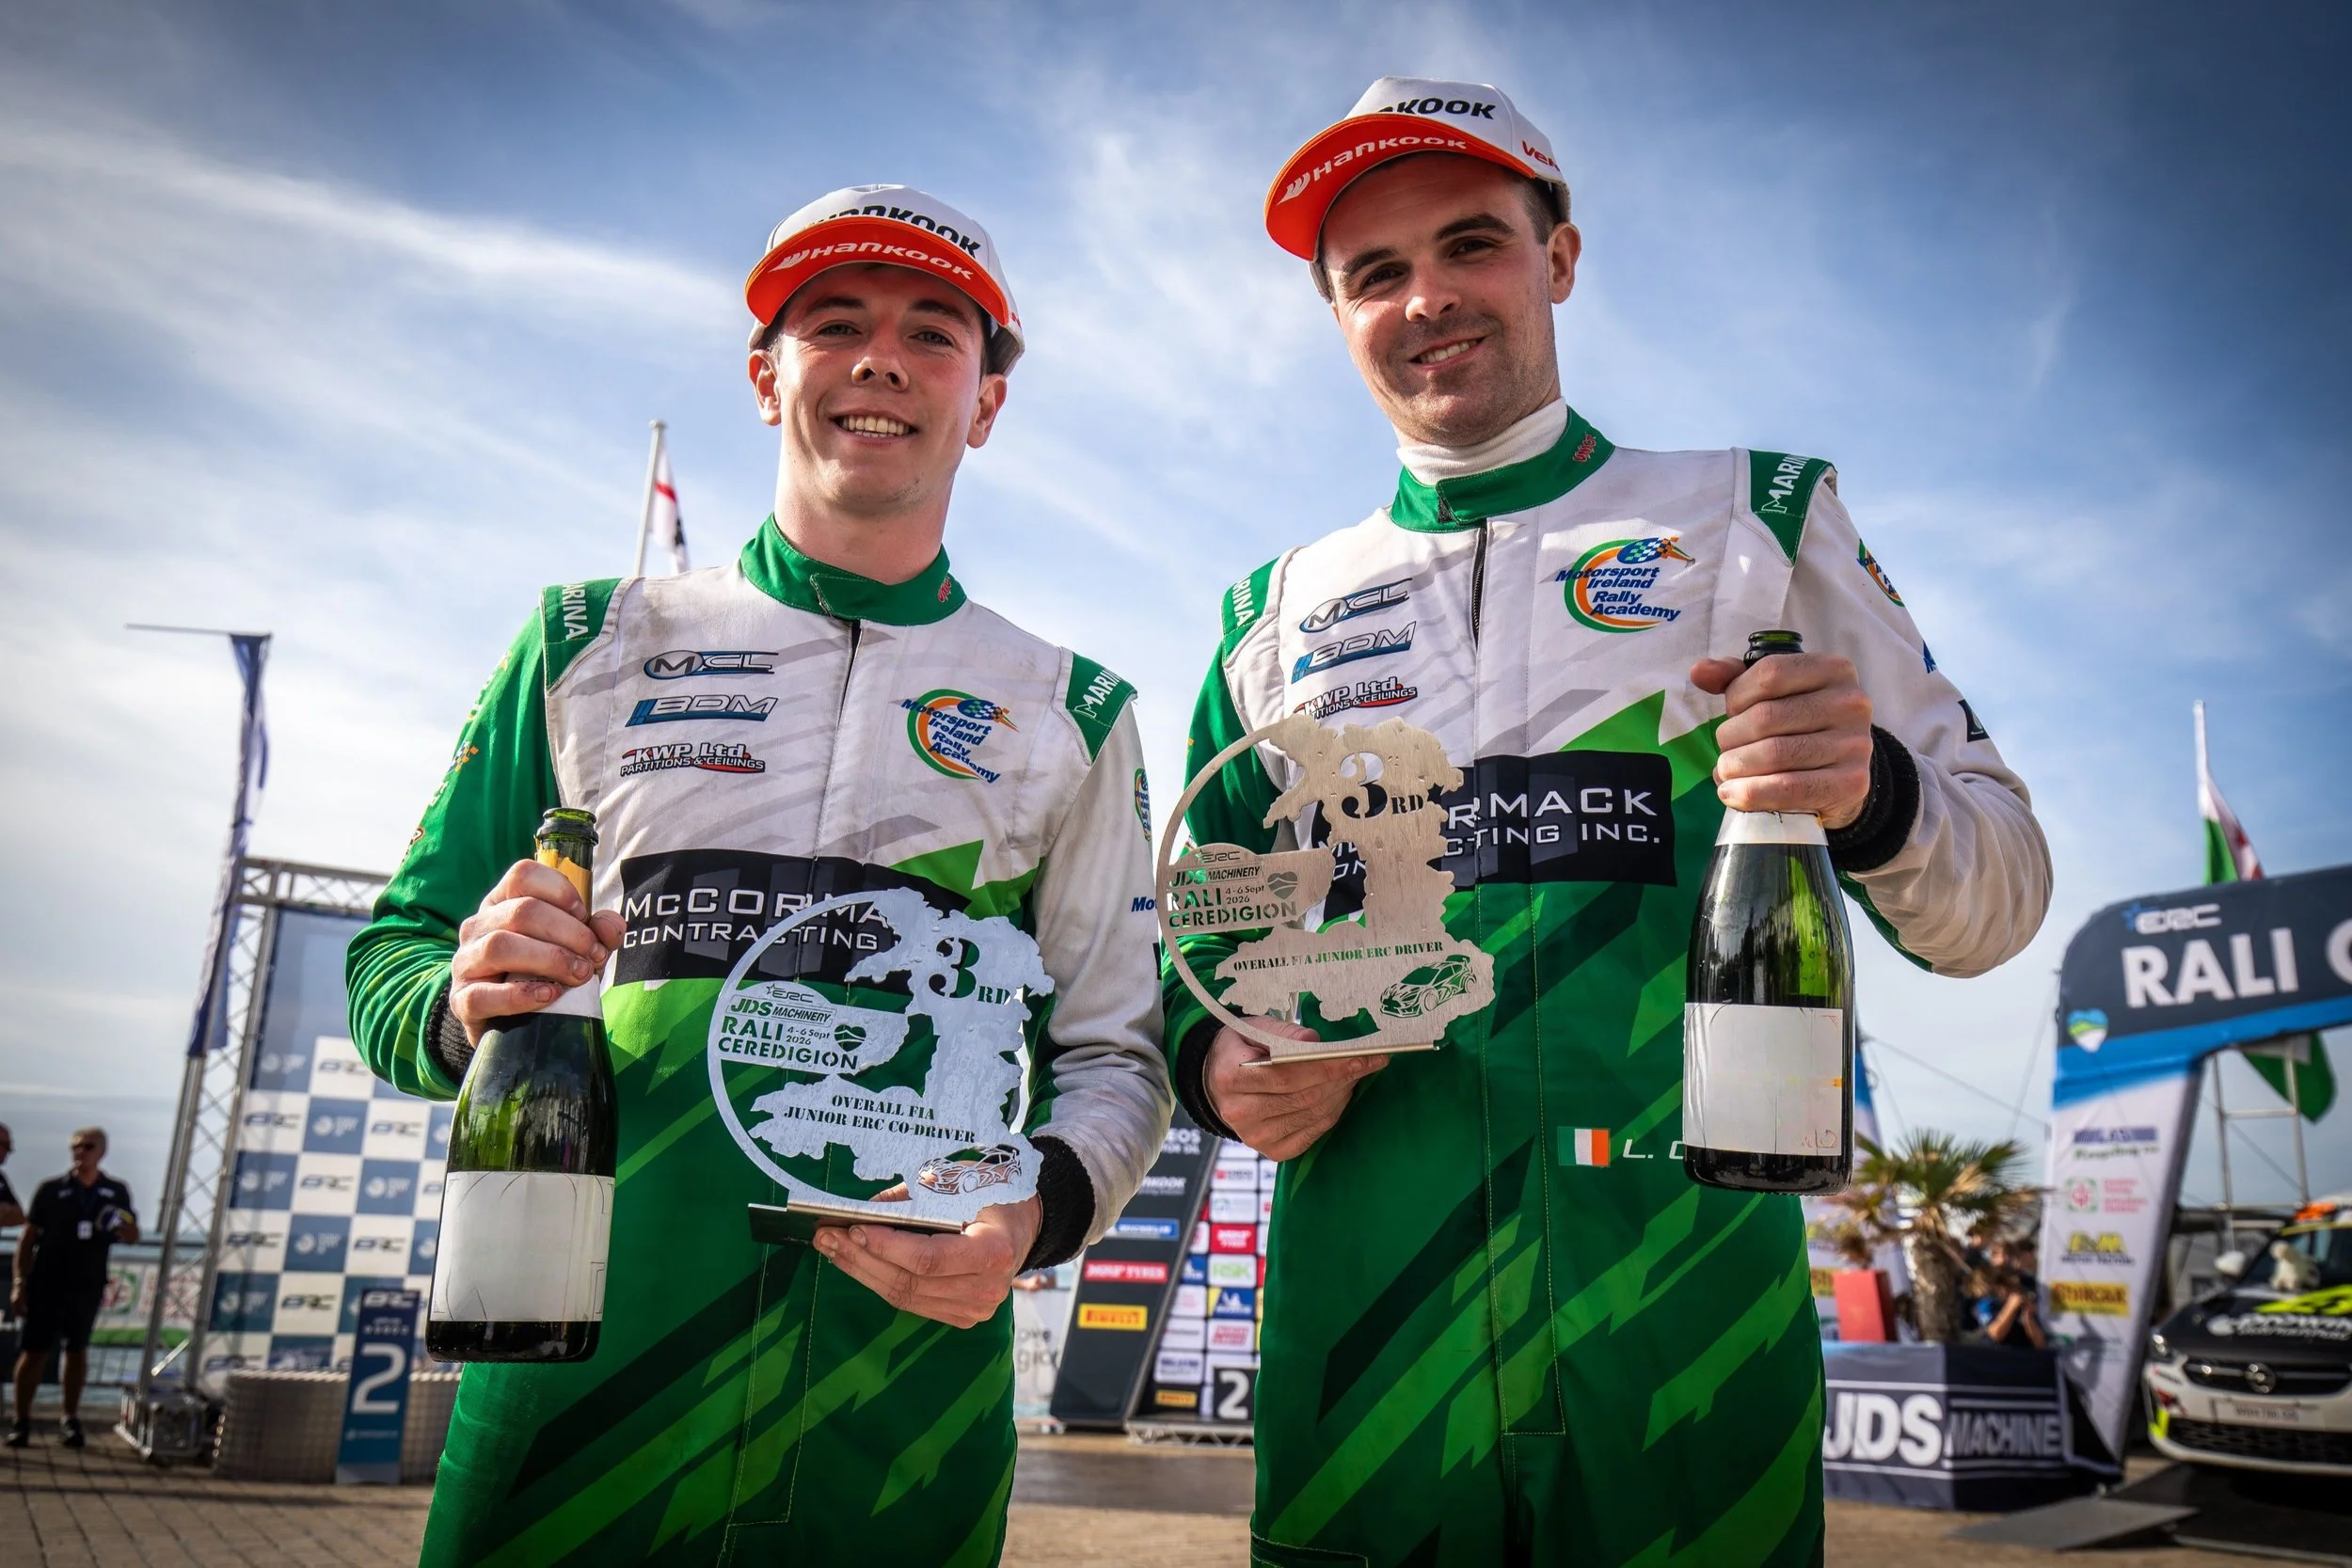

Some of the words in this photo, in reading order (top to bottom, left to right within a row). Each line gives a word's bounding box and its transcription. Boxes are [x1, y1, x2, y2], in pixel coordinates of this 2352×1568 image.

[1760, 456, 1810, 514] MARIN
[1555, 566, 1661, 582] Motorsport
[1586, 577, 1654, 590] Ireland
[1592, 590, 1642, 605] Rally
[1590, 602, 1682, 622] Academy
[1074, 670, 1122, 719] MARIN
[1304, 687, 1349, 715] KWP
[1357, 676, 1403, 696] Ltd.
[1352, 696, 1362, 706] &
[1363, 687, 1418, 704] CEILINGS
[900, 698, 993, 735] Motorsport
[928, 717, 986, 746] Ireland
[931, 731, 972, 757] Rally
[620, 755, 691, 776] PARTITIONS
[692, 755, 706, 767] &
[706, 757, 765, 772] CEILINGS
[634, 743, 692, 763] KWP
[699, 742, 752, 760] Ltd.
[929, 741, 1002, 784] Academy
[1581, 823, 1661, 844] INC.
[1169, 868, 1207, 887] JDS
[1208, 866, 1260, 881] MACHINERY
[1245, 885, 1264, 895] Sept
[1167, 888, 1222, 911] RALI
[1226, 895, 1250, 904] 2026
[1168, 901, 1297, 929] CEREDIGION
[623, 923, 878, 950] CONTRATING
[1233, 956, 1289, 972] OVERALL
[1292, 952, 1312, 967] FIA
[1315, 948, 1364, 965] JUNIOR
[1366, 945, 1391, 959] ERC
[1394, 941, 1444, 956] DRIVER
[2122, 927, 2299, 1008] RALI
[731, 996, 773, 1017] JDS
[771, 1006, 832, 1024] MACHINERY
[721, 1016, 783, 1041] RALI
[786, 1035, 812, 1046] 2026
[808, 1029, 830, 1040] Sept
[718, 1037, 859, 1070] CEREDIGION
[832, 1094, 905, 1117] OVERALL
[907, 1104, 935, 1121] FIA
[784, 1106, 848, 1127] JUNIOR
[851, 1115, 885, 1132] ERC
[888, 1120, 976, 1144] CO-DRIVER
[351, 1342, 405, 1414] 2
[1217, 1370, 1249, 1419] 2
[1822, 1392, 1943, 1466] JDS
